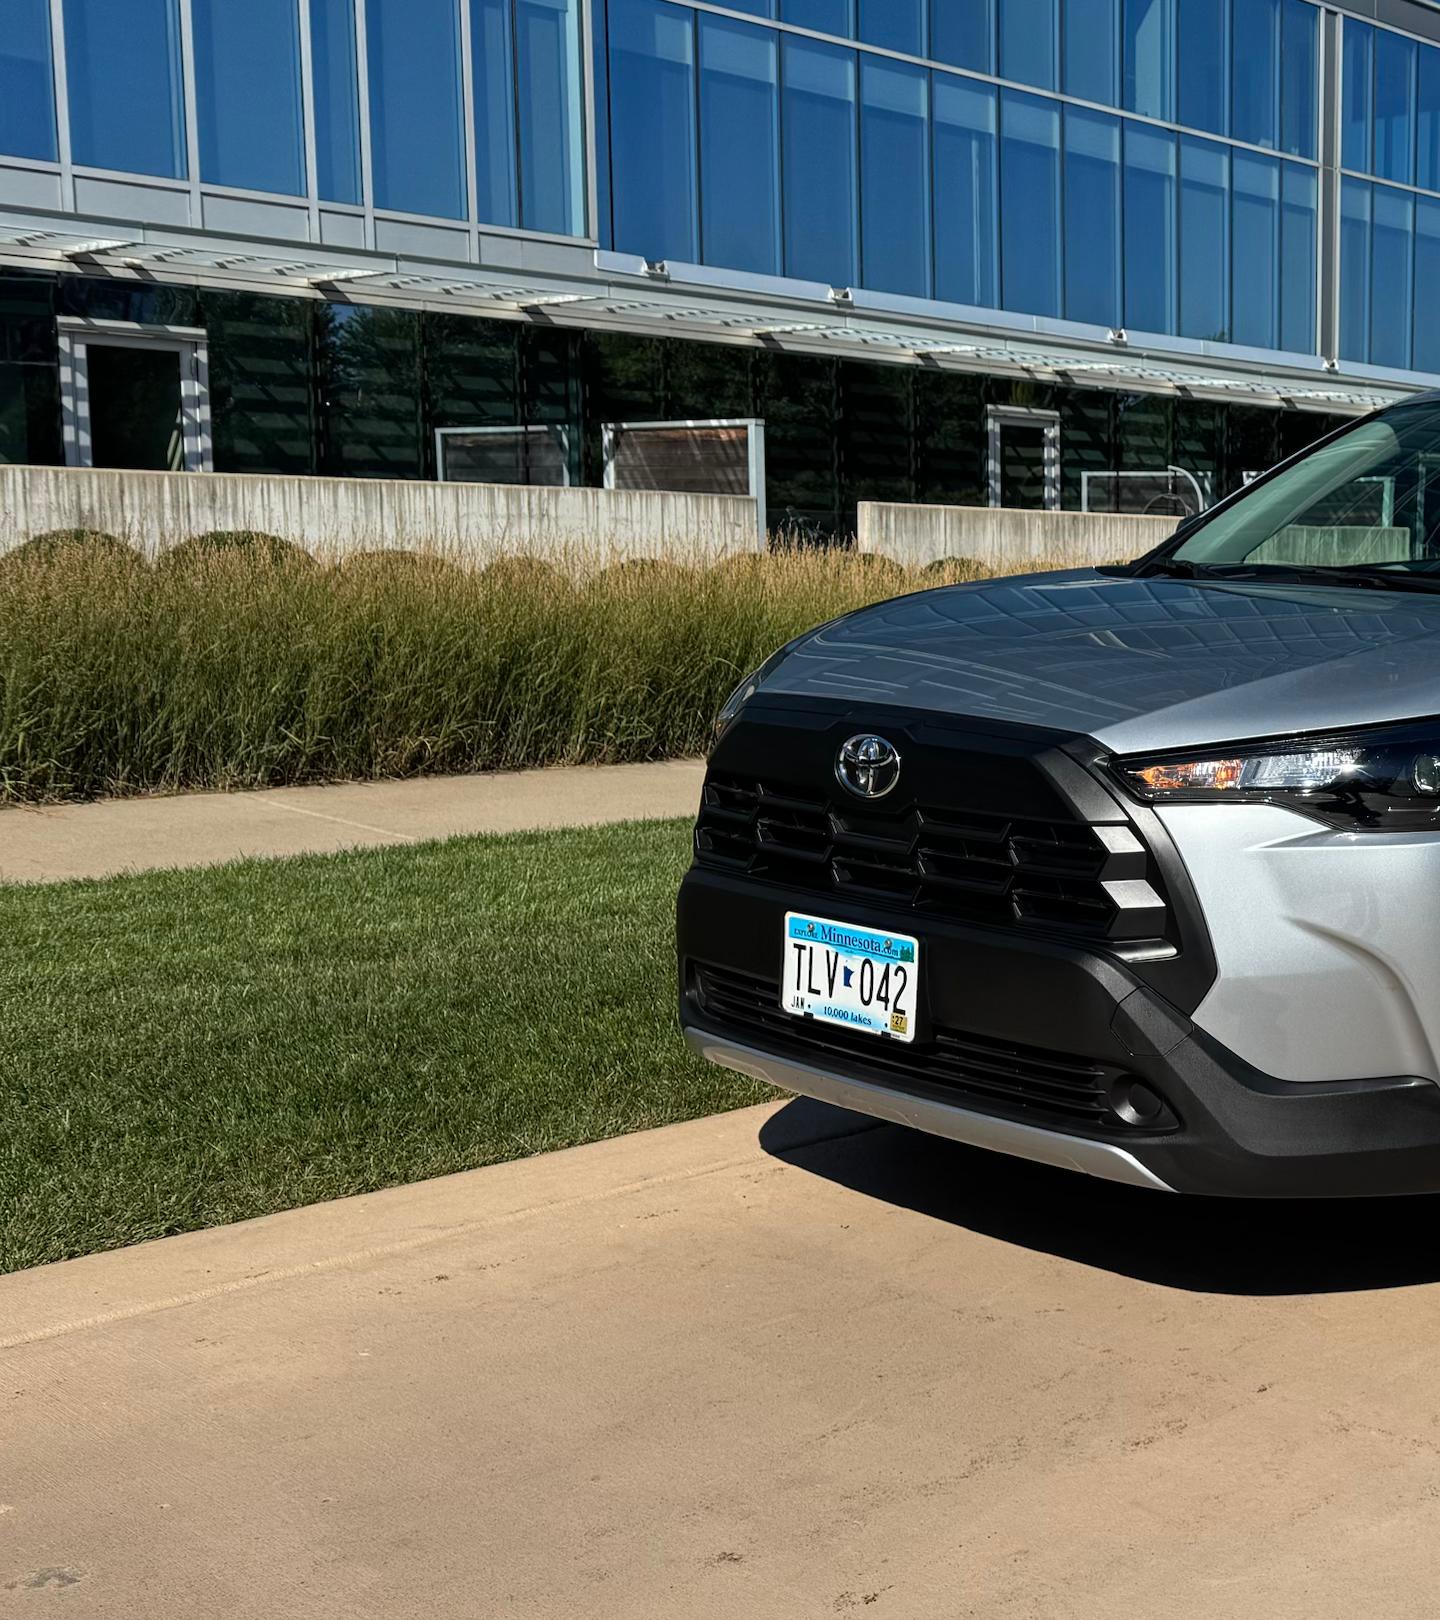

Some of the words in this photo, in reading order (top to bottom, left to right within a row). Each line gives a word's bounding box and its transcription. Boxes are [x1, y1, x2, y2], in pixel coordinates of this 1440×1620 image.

[820, 925, 899, 957] Minnesota.com
[793, 943, 839, 999] TLV
[860, 958, 907, 1016] 042
[823, 1006, 849, 1020] 10,000
[850, 1011, 872, 1026] lakes
[895, 1015, 904, 1026] 27
